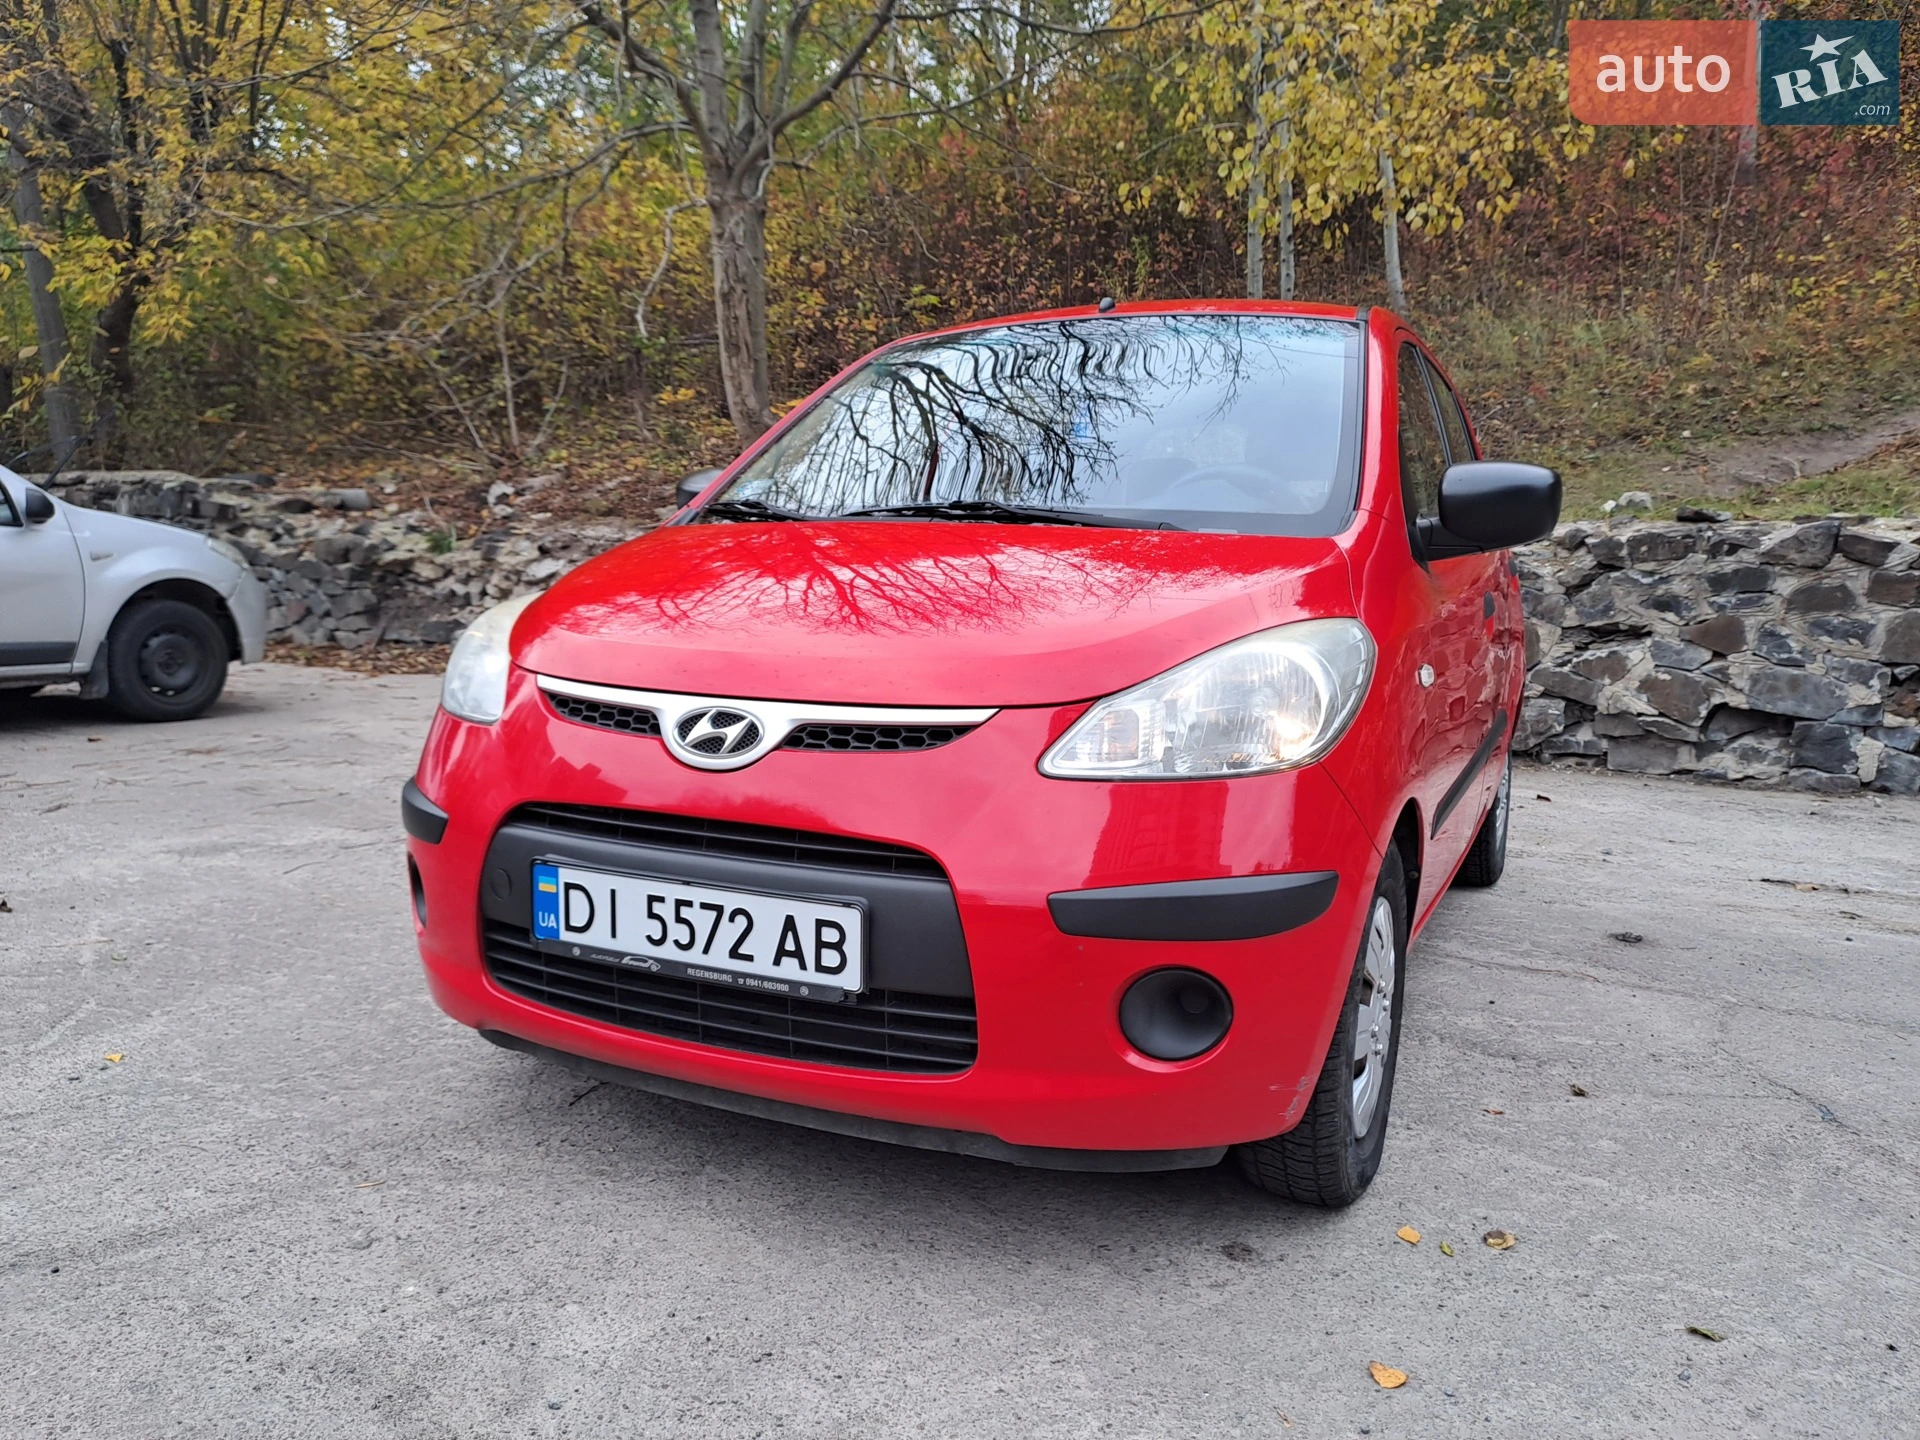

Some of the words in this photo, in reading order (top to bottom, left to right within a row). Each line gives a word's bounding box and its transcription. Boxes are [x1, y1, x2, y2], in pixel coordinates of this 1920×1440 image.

[538, 911, 557, 929] UA
[563, 882, 616, 939] DI
[645, 894, 754, 962] 5572
[772, 914, 847, 975] AB
[687, 968, 732, 982] REGENSBURG
